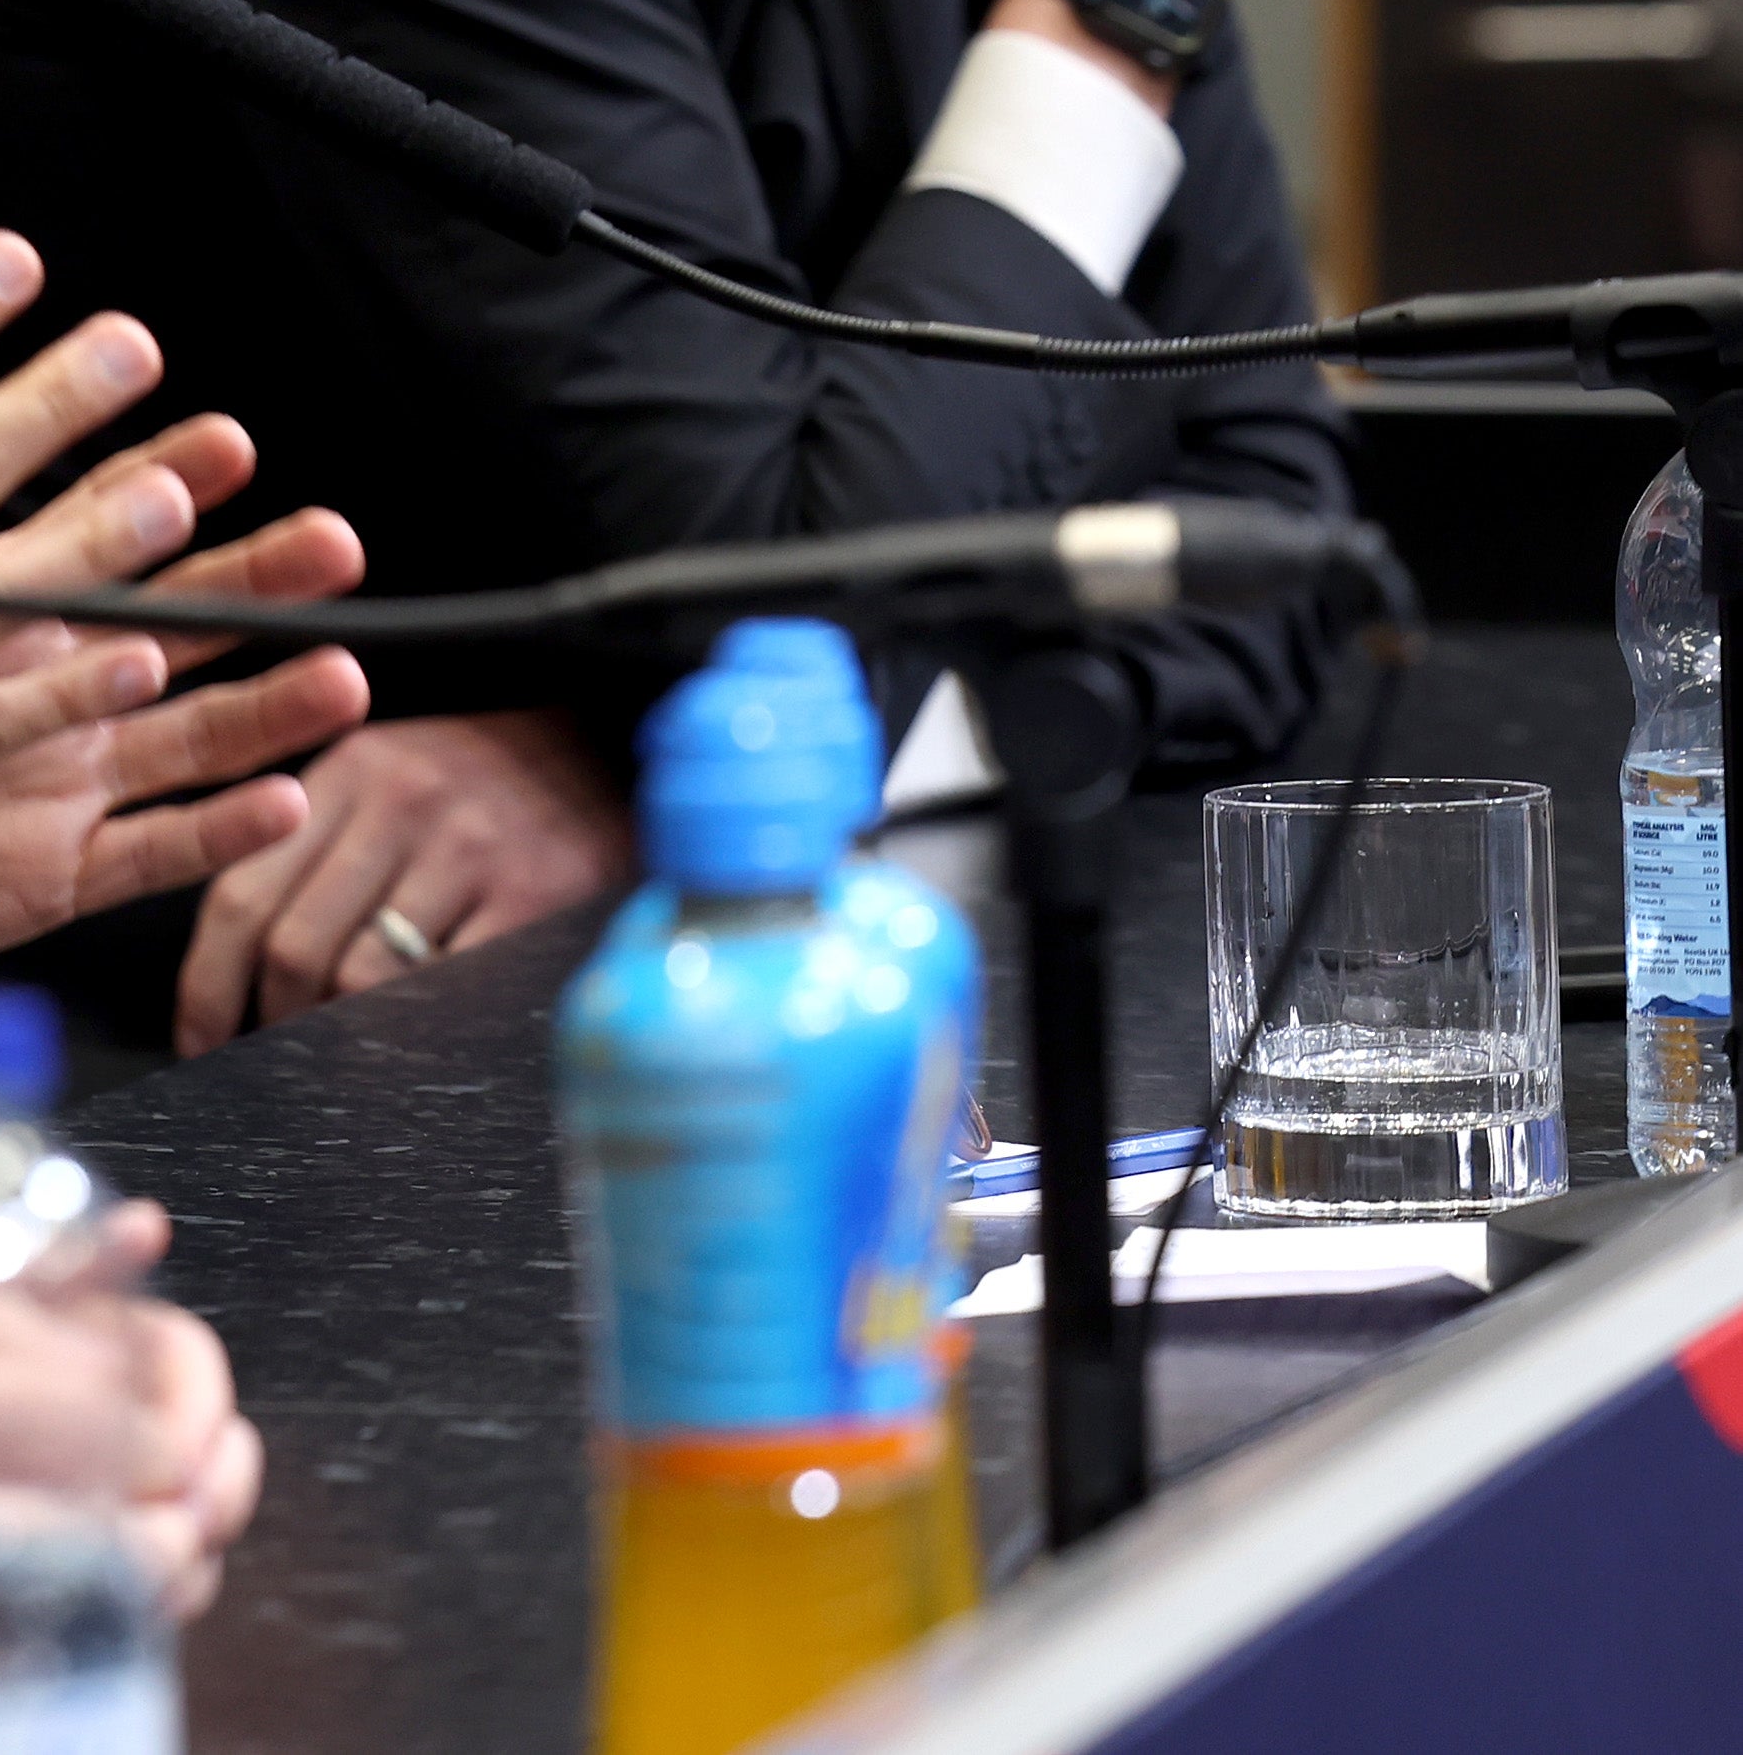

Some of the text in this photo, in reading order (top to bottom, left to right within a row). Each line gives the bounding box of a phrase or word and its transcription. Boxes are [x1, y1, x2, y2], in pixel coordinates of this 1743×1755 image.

[1653, 822, 1684, 831] ANALYSIS
[1696, 832, 1718, 841] LITRE
[1673, 933, 1698, 943] Water
[1684, 958, 1695, 966] PO
[1696, 958, 1711, 966] Box
